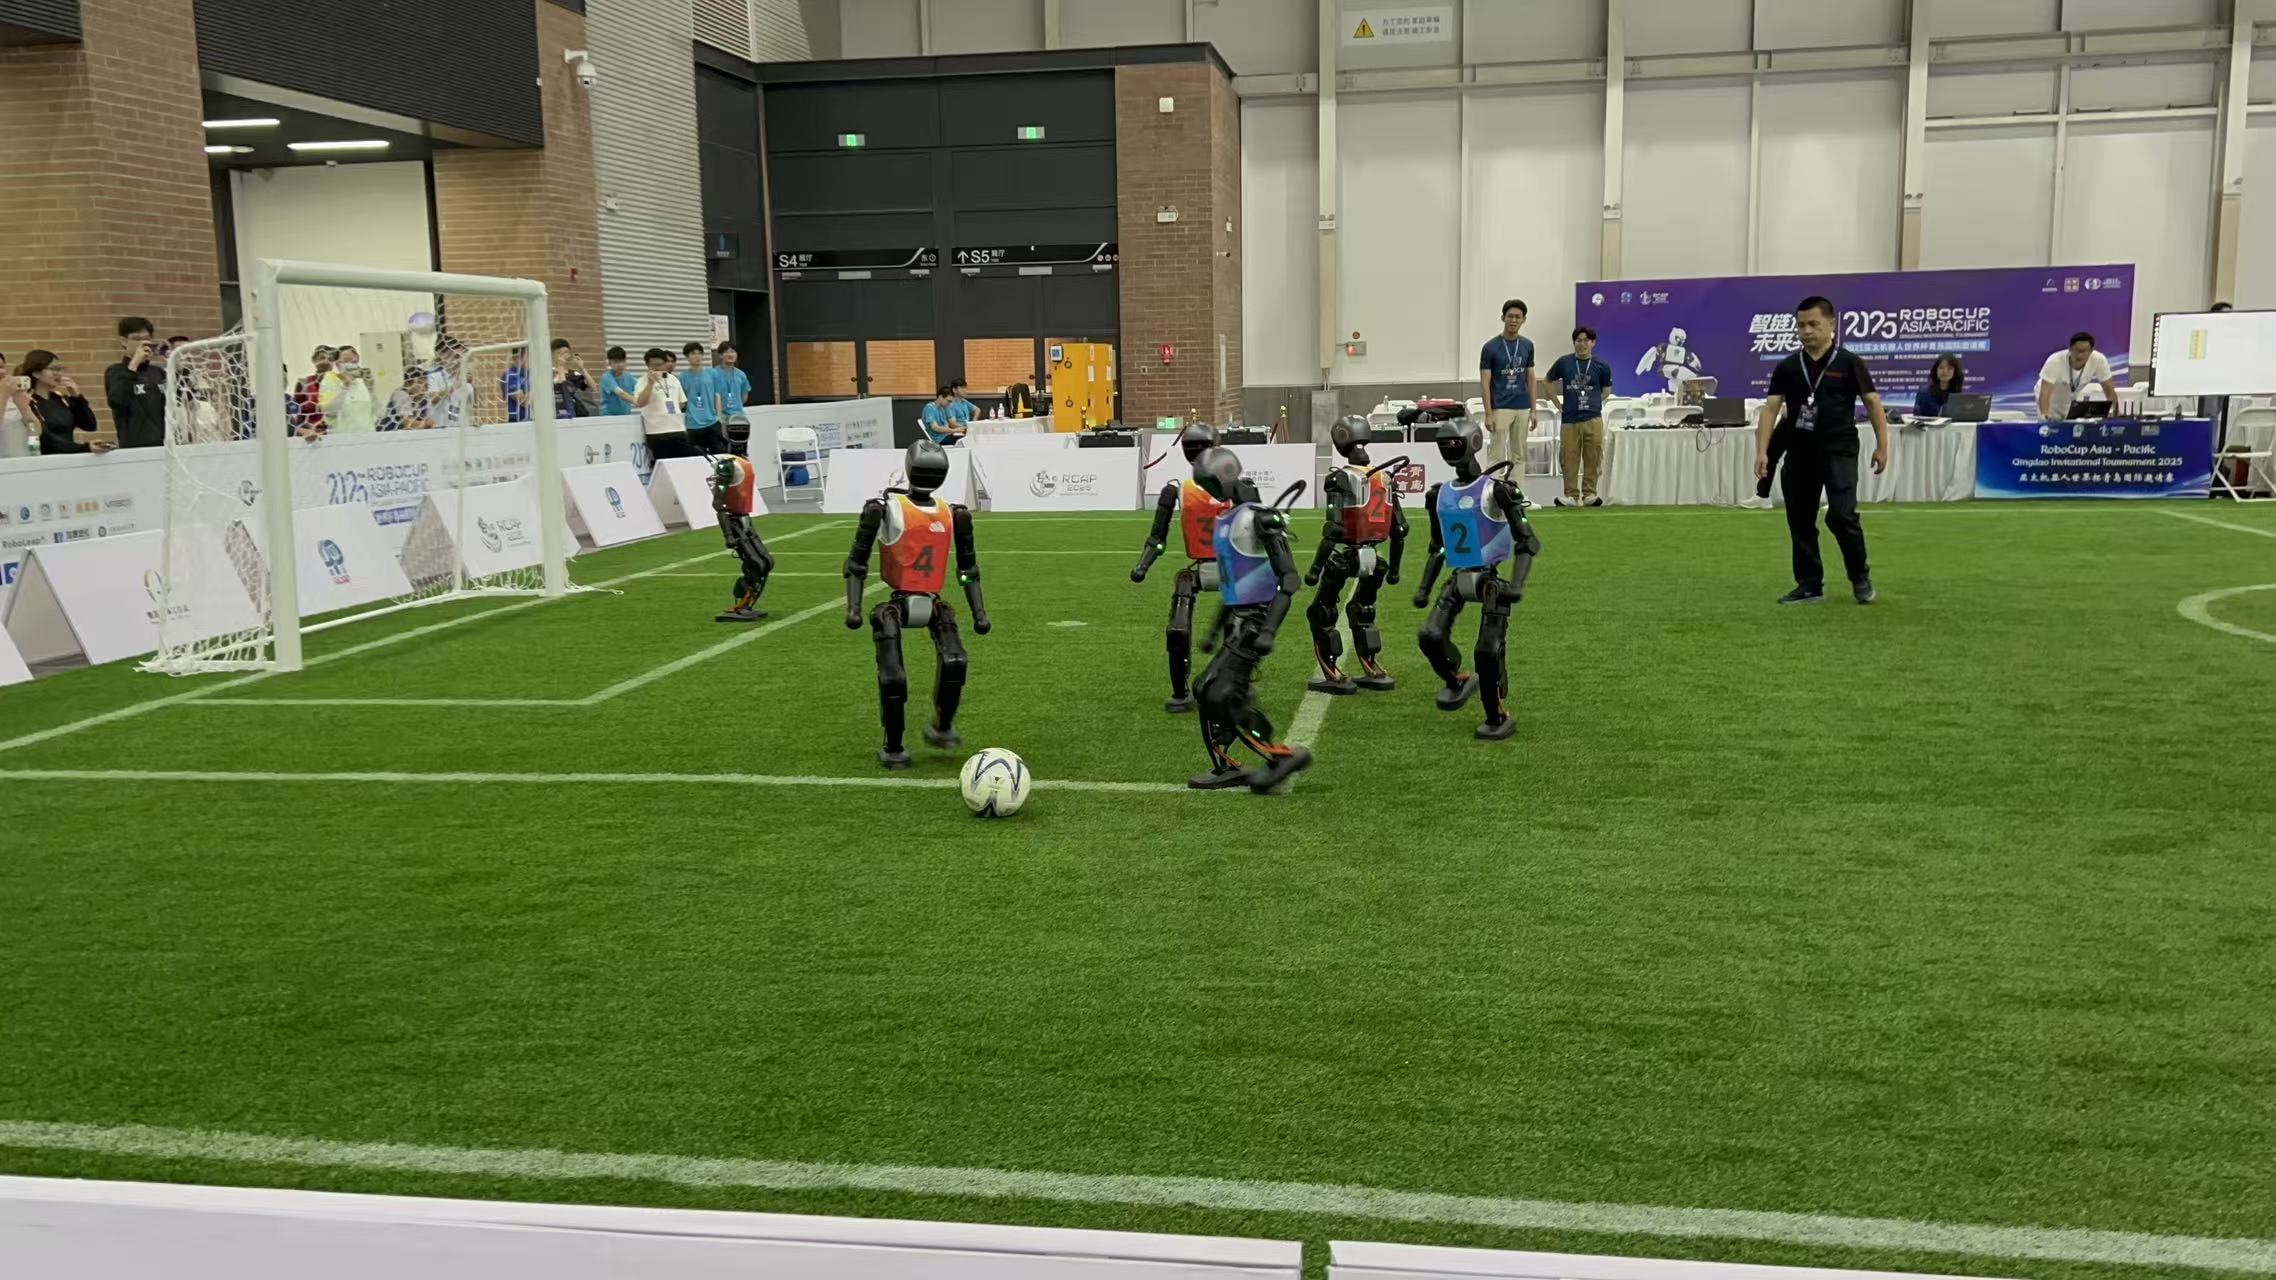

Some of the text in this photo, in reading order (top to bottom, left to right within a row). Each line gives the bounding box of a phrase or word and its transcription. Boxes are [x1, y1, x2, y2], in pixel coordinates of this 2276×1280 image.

[779, 254, 798, 268] S4
[970, 250, 990, 263] S5
[1900, 307, 1990, 320] ROBOCUP
[1843, 310, 1897, 339] 2025
[1900, 319, 1990, 333] ASIA-PACIFIC
[2040, 444, 2088, 456] RoboCup
[2090, 444, 2112, 455] Asia
[2123, 444, 2157, 455] Pacific
[2012, 457, 2183, 468] Qingdao Invitational Tournament 2025
[1062, 474, 1097, 483] RCAP
[1371, 491, 1385, 520] 2
[1450, 522, 1472, 554] 2
[913, 544, 934, 577] 4
